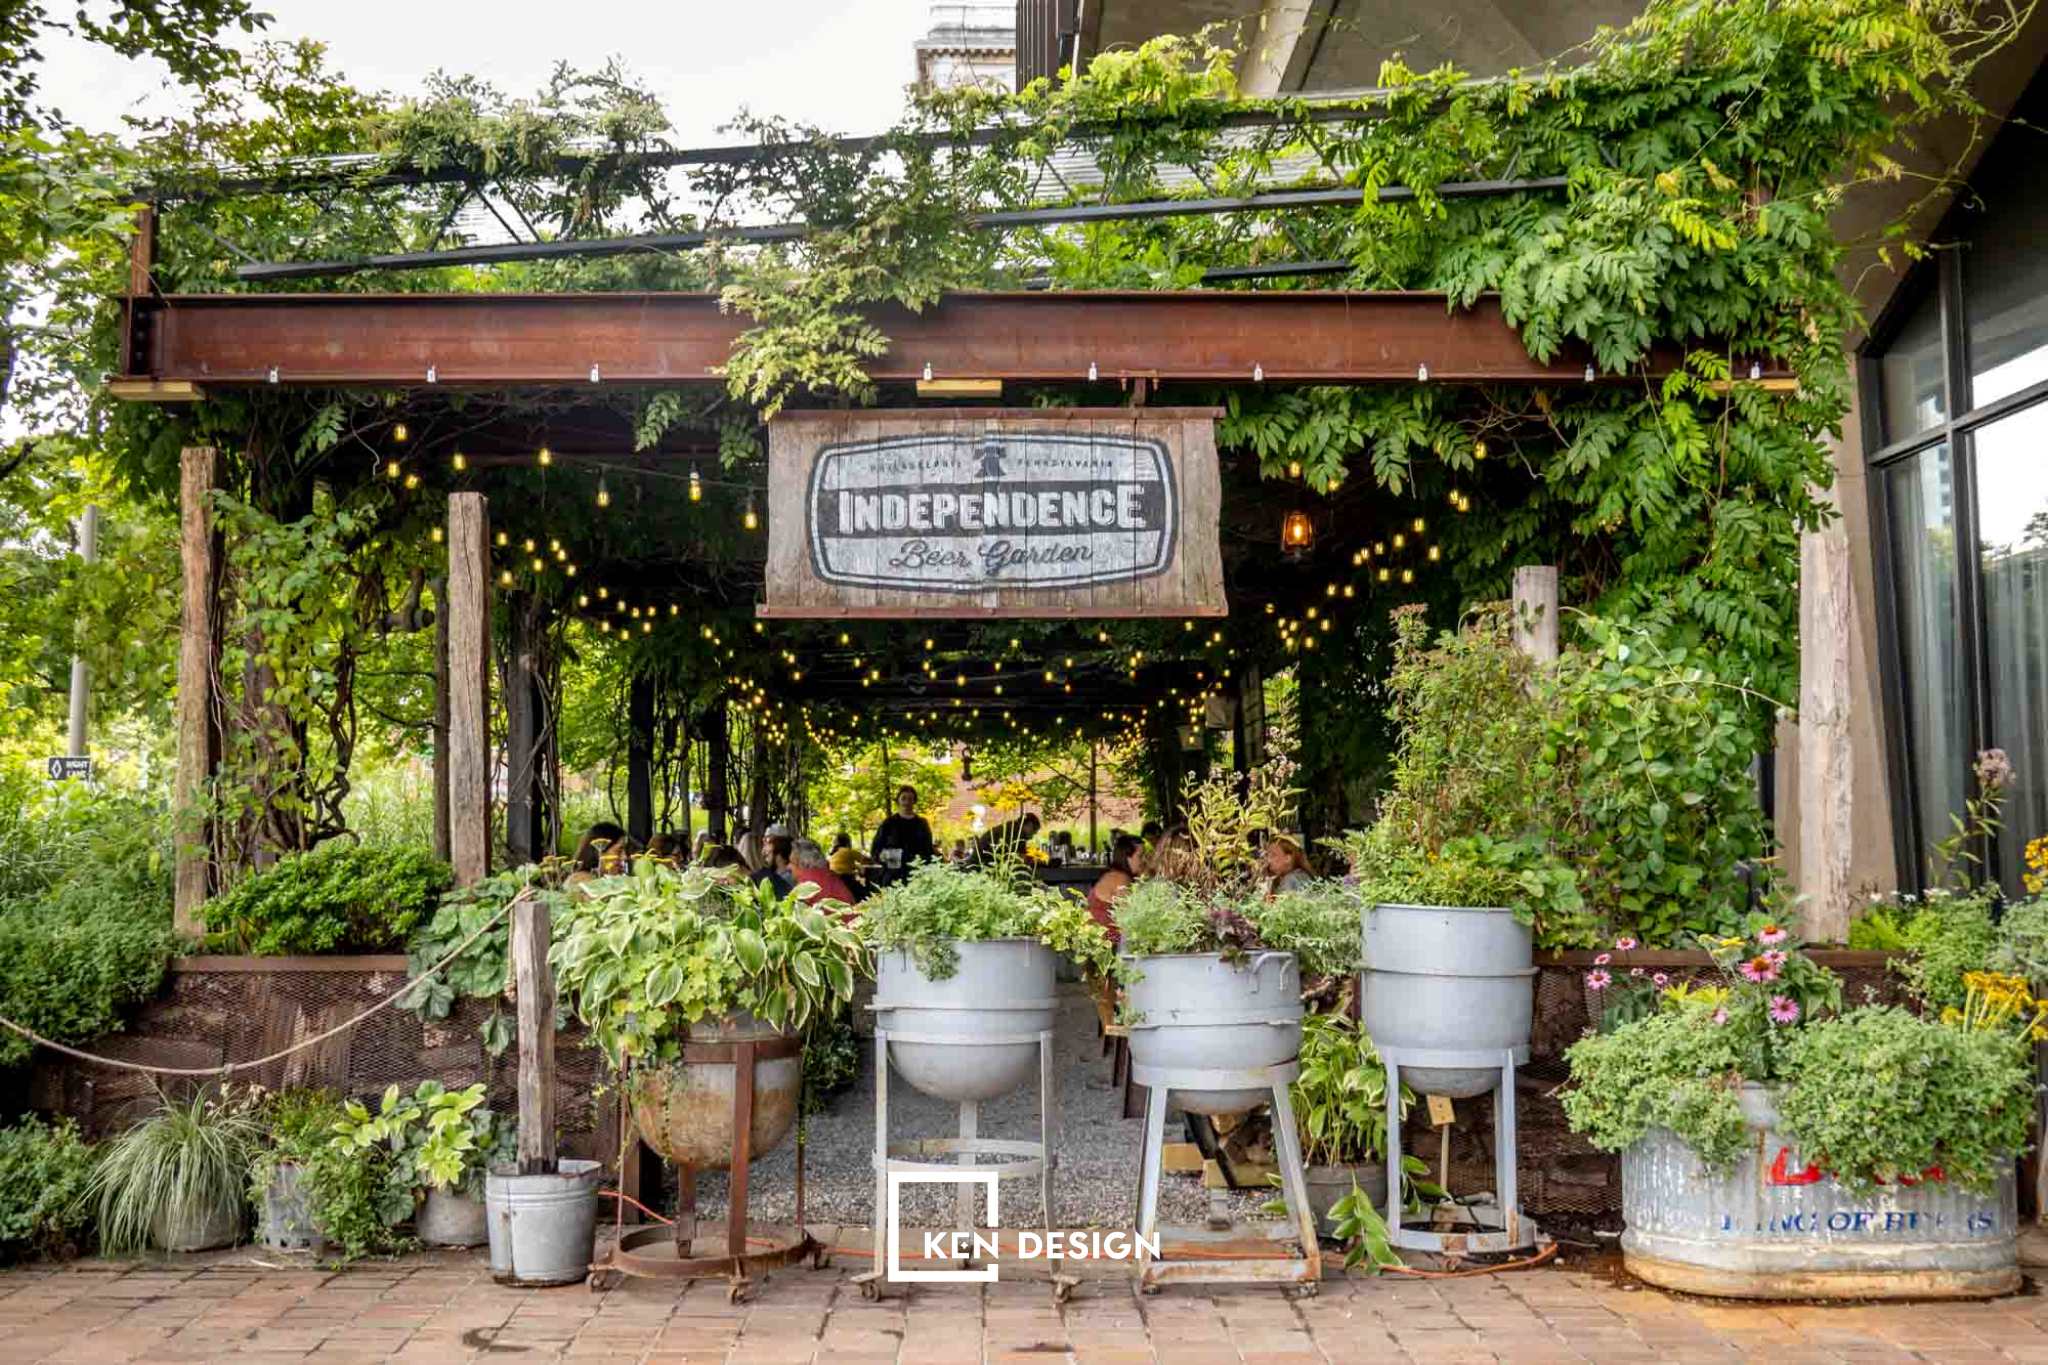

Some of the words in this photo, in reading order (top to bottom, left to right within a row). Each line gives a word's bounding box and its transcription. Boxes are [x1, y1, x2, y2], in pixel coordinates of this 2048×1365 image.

[838, 483, 1147, 535] INDEPENDENCE
[889, 539, 972, 569] Beer
[978, 540, 1094, 577] Garden
[1827, 1211, 1876, 1232] OF
